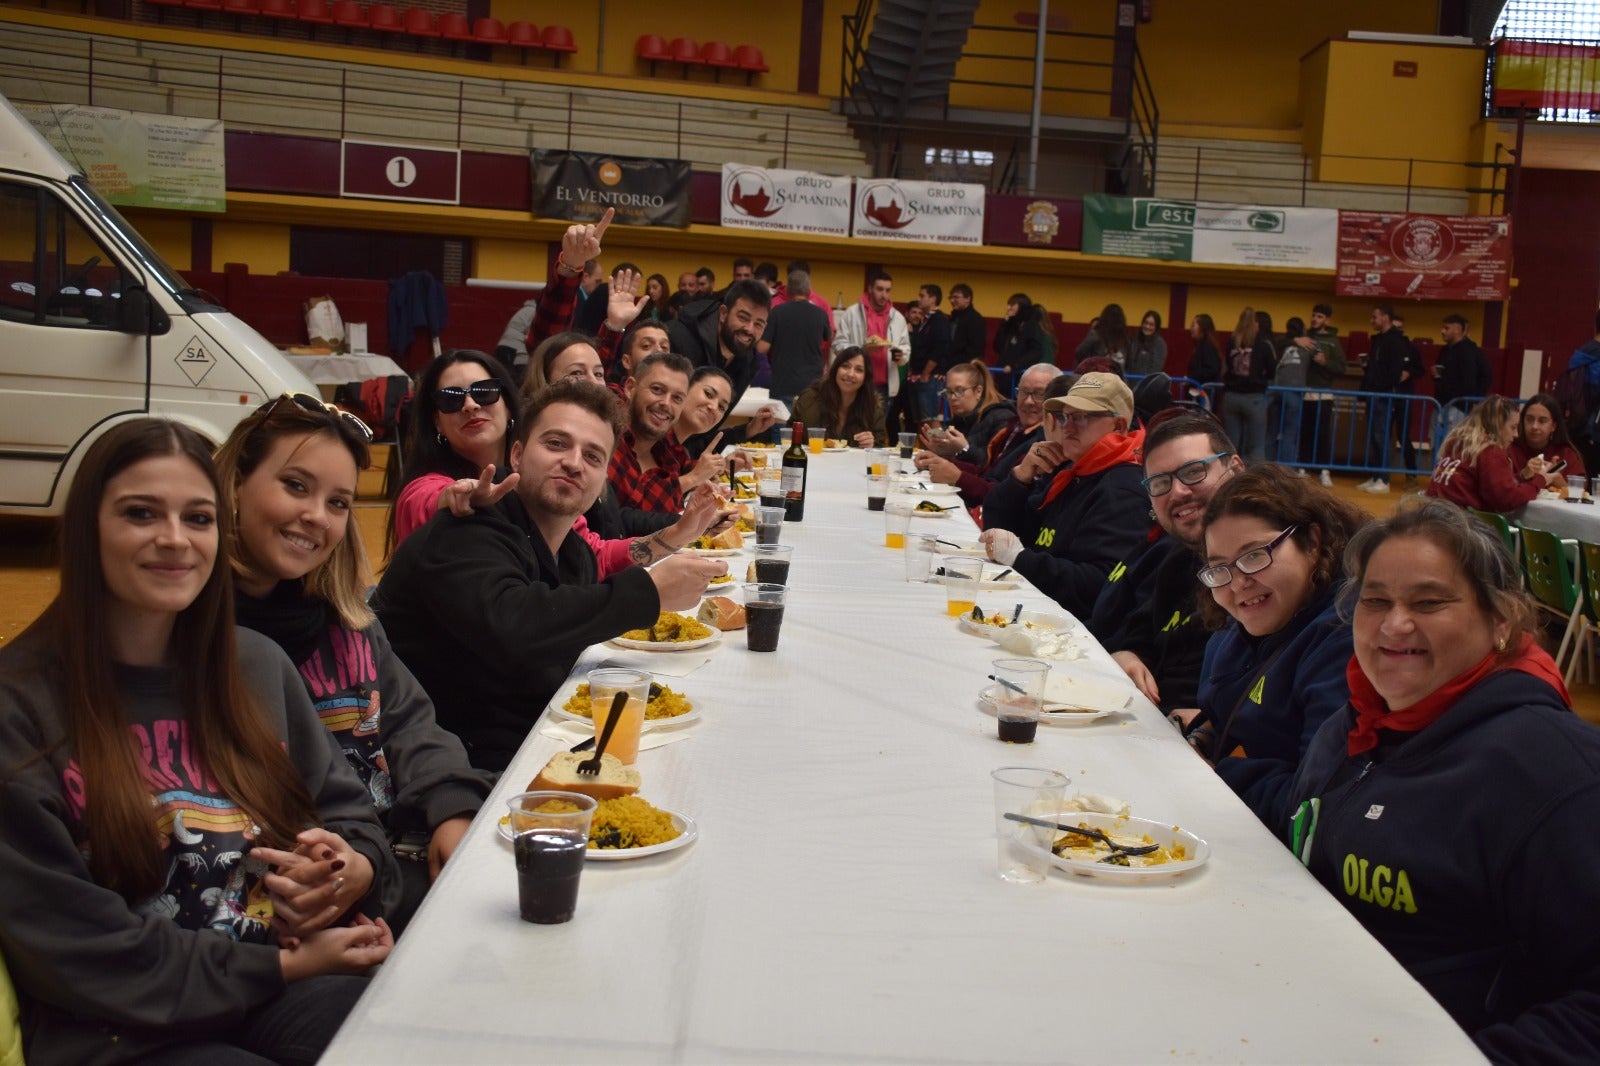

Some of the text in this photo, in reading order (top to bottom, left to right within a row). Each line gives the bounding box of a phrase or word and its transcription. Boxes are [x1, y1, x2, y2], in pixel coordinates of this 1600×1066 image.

[395, 158, 407, 184] 1
[795, 176, 833, 189] GRUPO
[555, 185, 664, 208] EL VENTORRO
[927, 187, 966, 200] GRUPO
[1161, 209, 1193, 225] est
[723, 217, 794, 231] CONSTRUCCIONES
[803, 225, 846, 235] REFORMAS
[856, 228, 928, 241] CONSTRUCCIONES
[937, 234, 979, 243] REFORMAS
[186, 347, 206, 359] SA
[1342, 853, 1419, 915] OLGA
